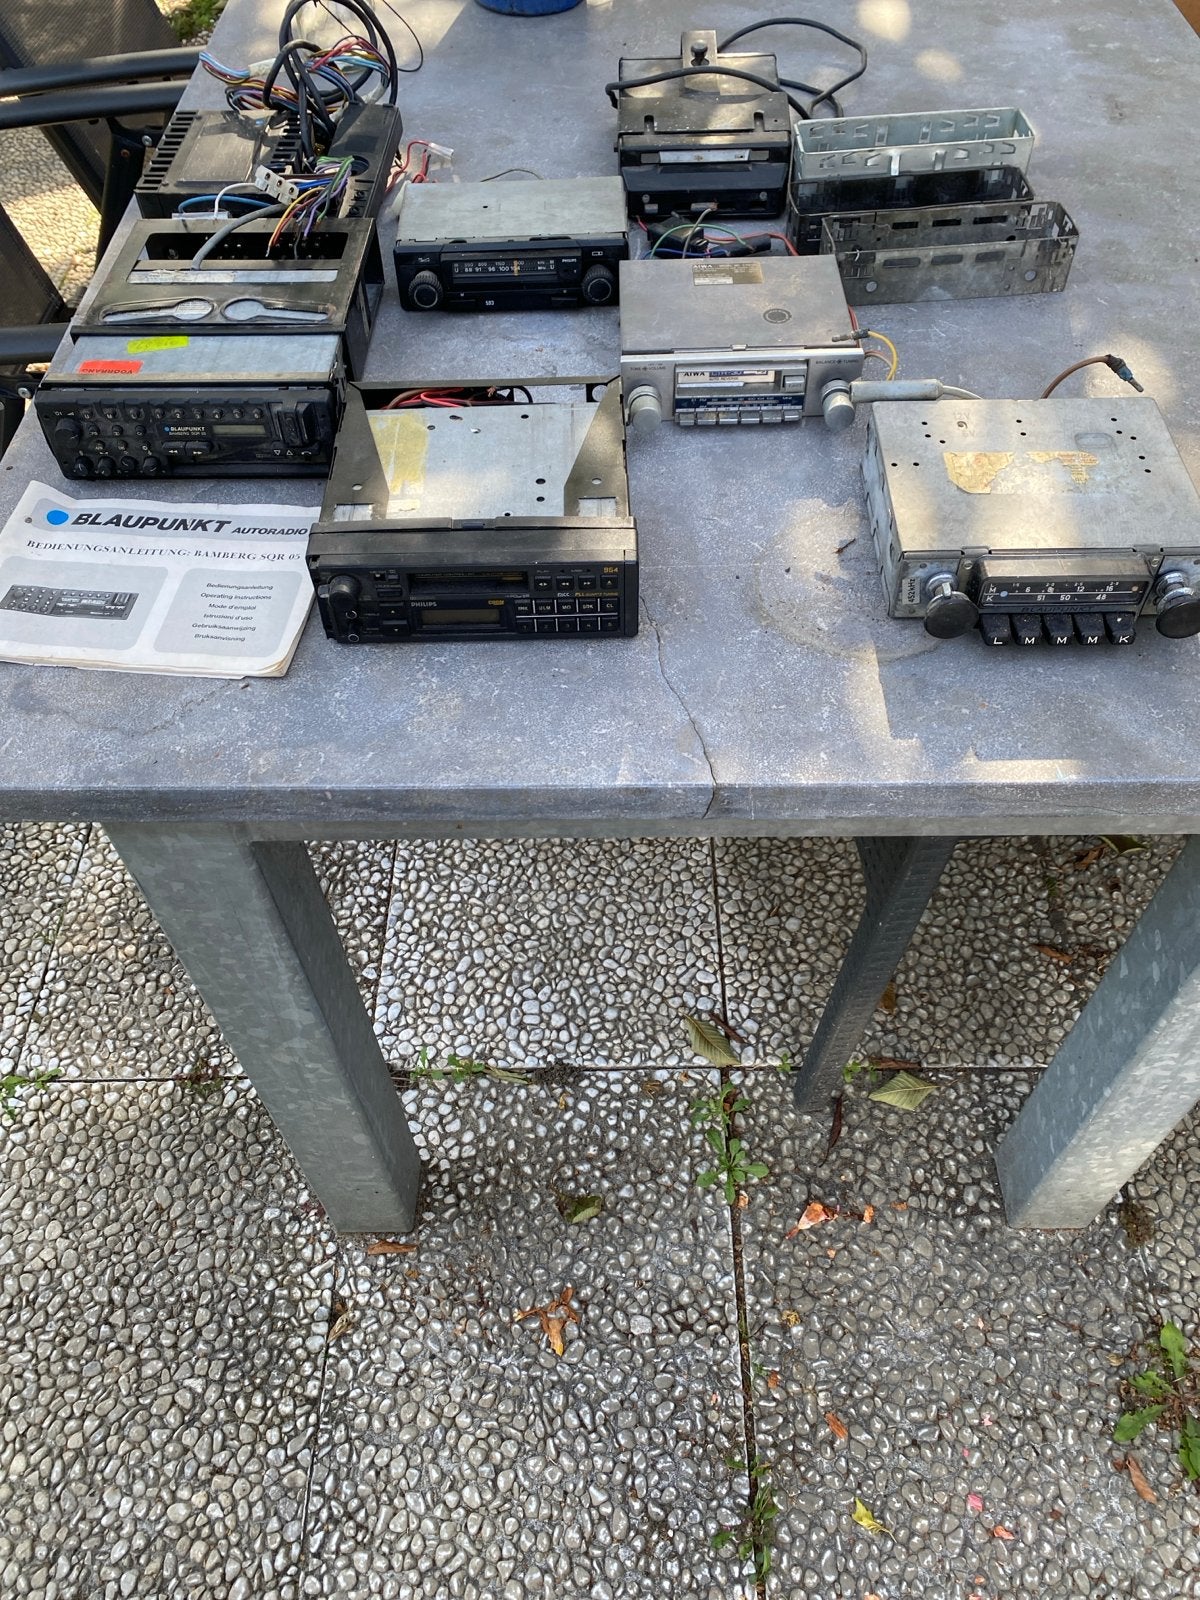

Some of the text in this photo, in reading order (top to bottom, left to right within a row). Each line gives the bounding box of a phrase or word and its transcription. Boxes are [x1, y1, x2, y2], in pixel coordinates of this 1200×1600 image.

[71, 512, 308, 535] BLAUPUNKT AUTORADIO
[26, 540, 191, 557] BEDIENUNGSANLEITUNG:
[194, 549, 257, 560] BAMBERG
[260, 553, 285, 561] SQR
[200, 592, 233, 600] Operating
[192, 623, 257, 631] Gebruiksaanwijzing
[194, 633, 246, 642] Bruksanvisning
[993, 637, 1003, 645] L
[1024, 637, 1035, 645] M
[1056, 636, 1068, 644] M
[1087, 636, 1098, 644] M
[1119, 635, 1130, 643] K
